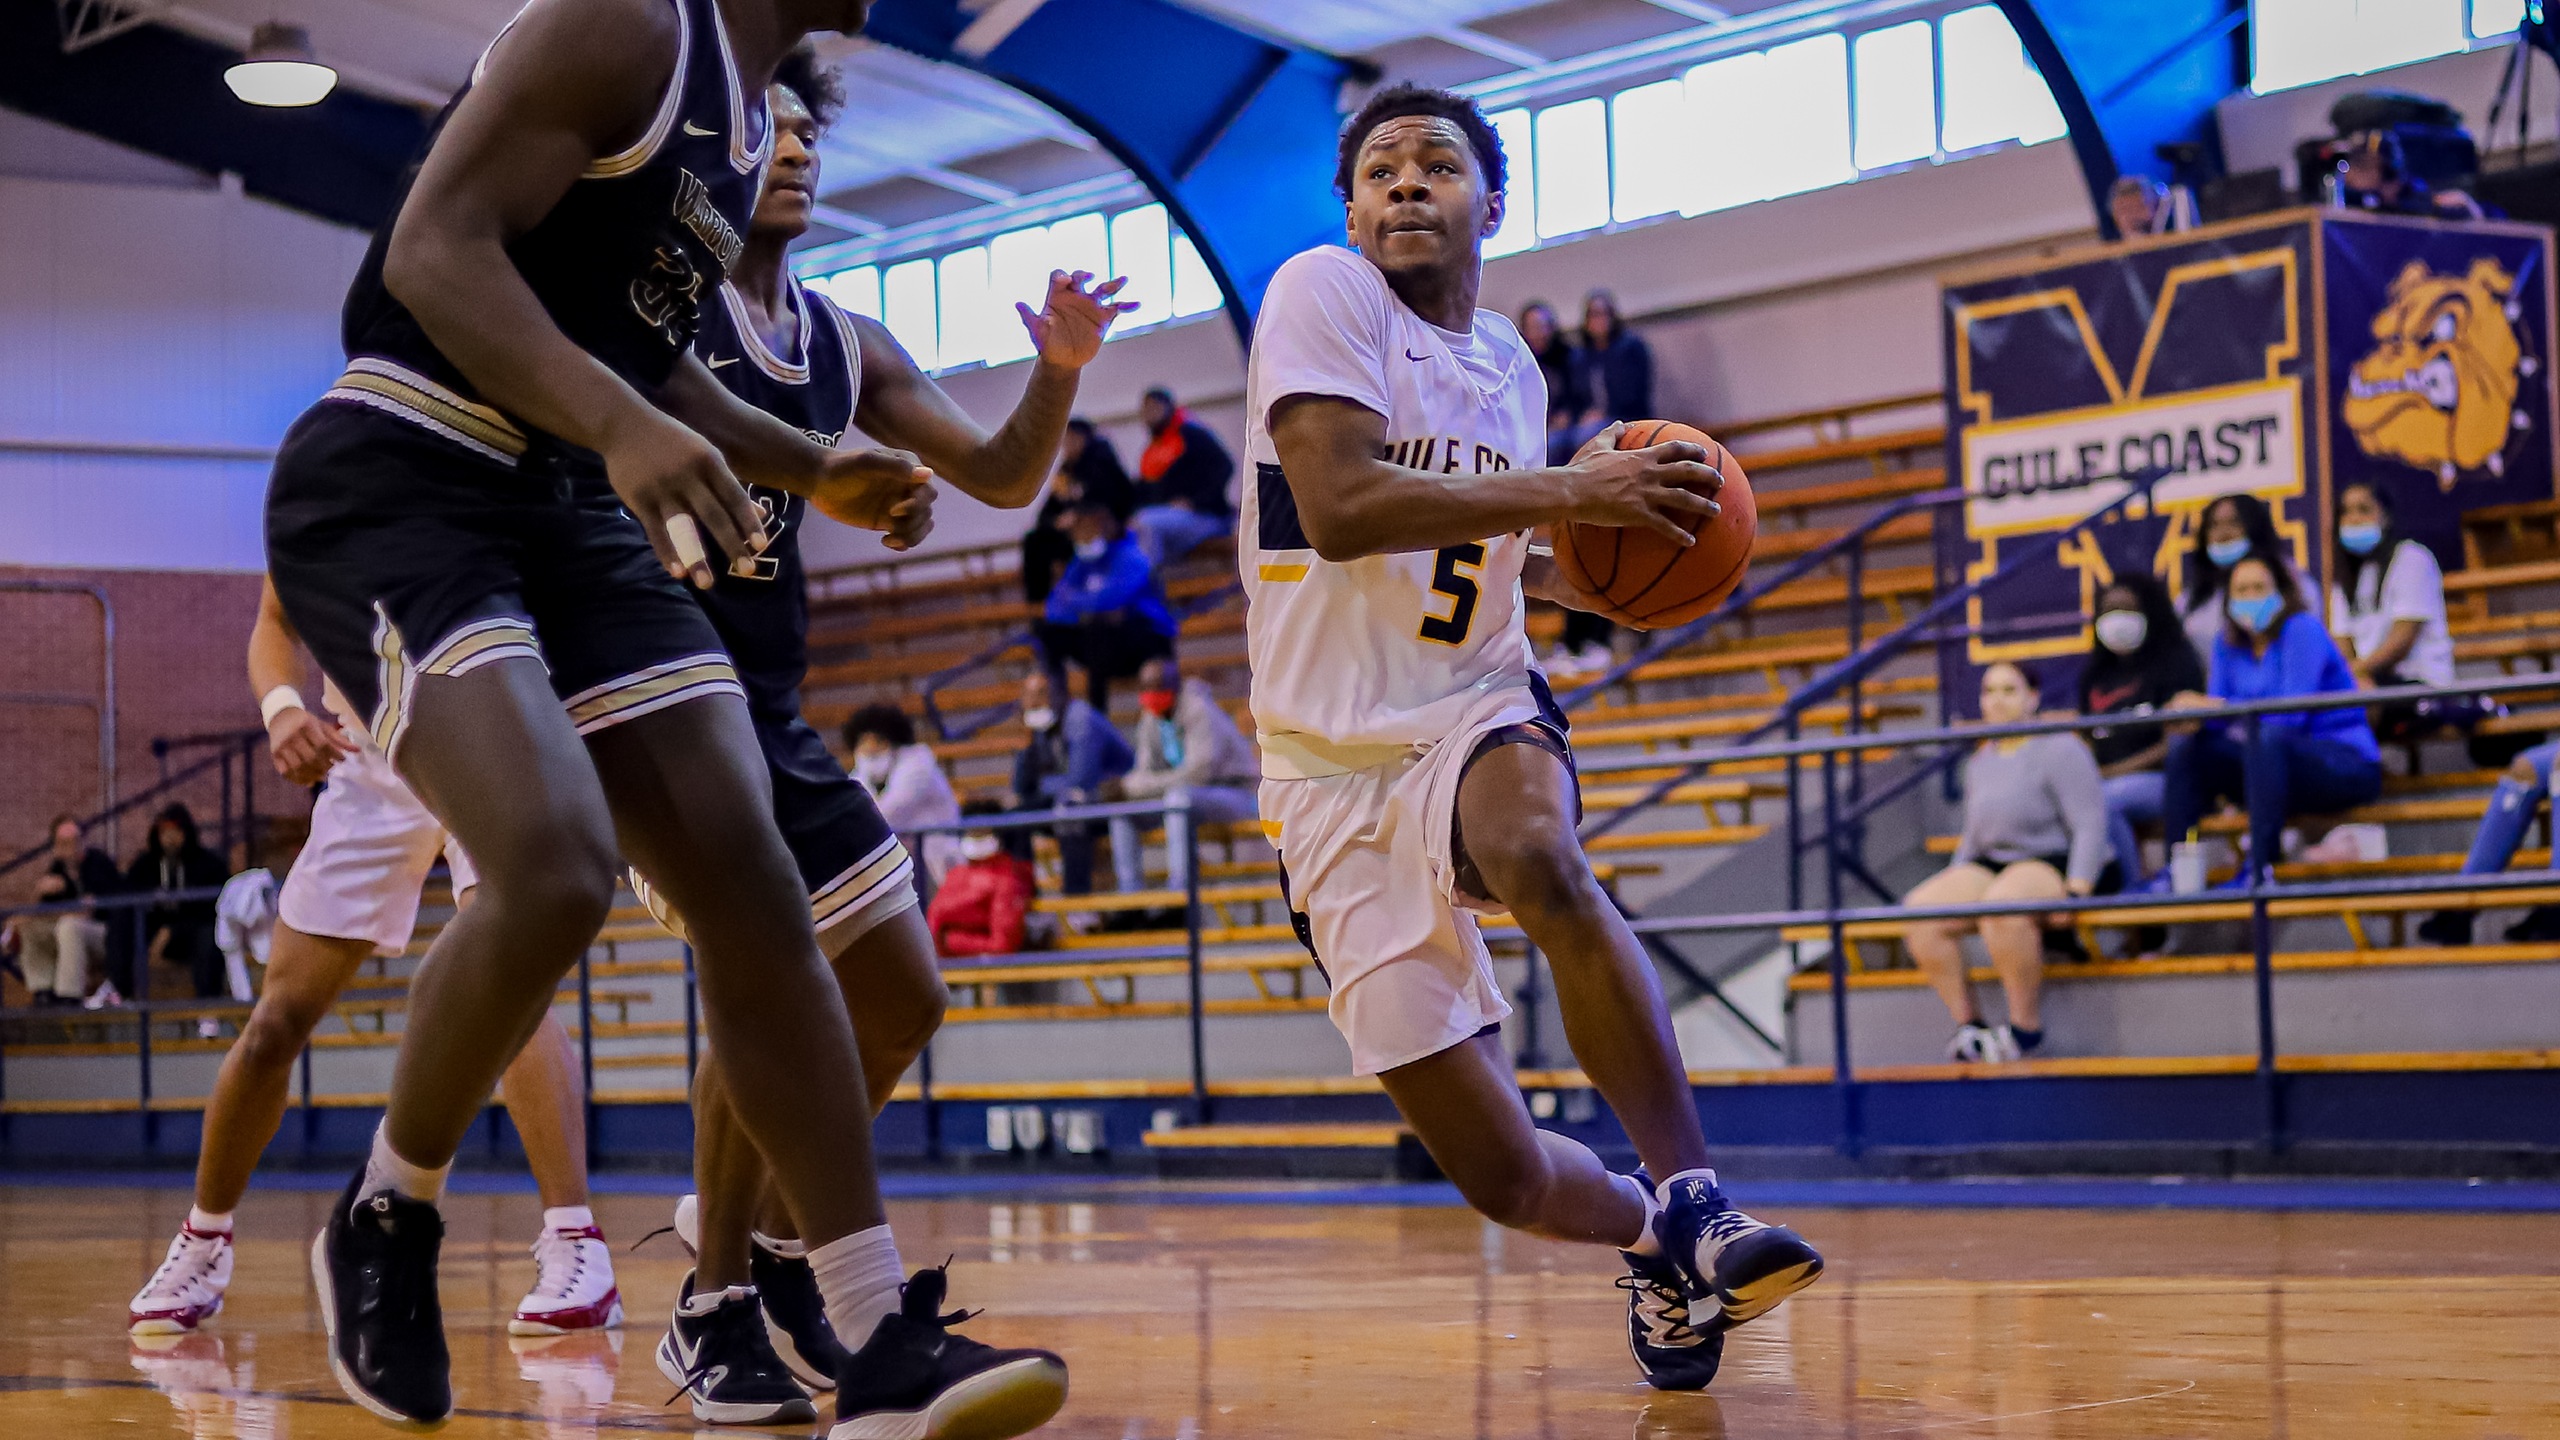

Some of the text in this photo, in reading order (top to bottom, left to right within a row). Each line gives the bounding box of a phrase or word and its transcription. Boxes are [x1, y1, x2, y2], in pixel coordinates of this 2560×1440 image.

[1984, 417, 2278, 499] GULF COAST
[1416, 540, 1488, 648] 5
